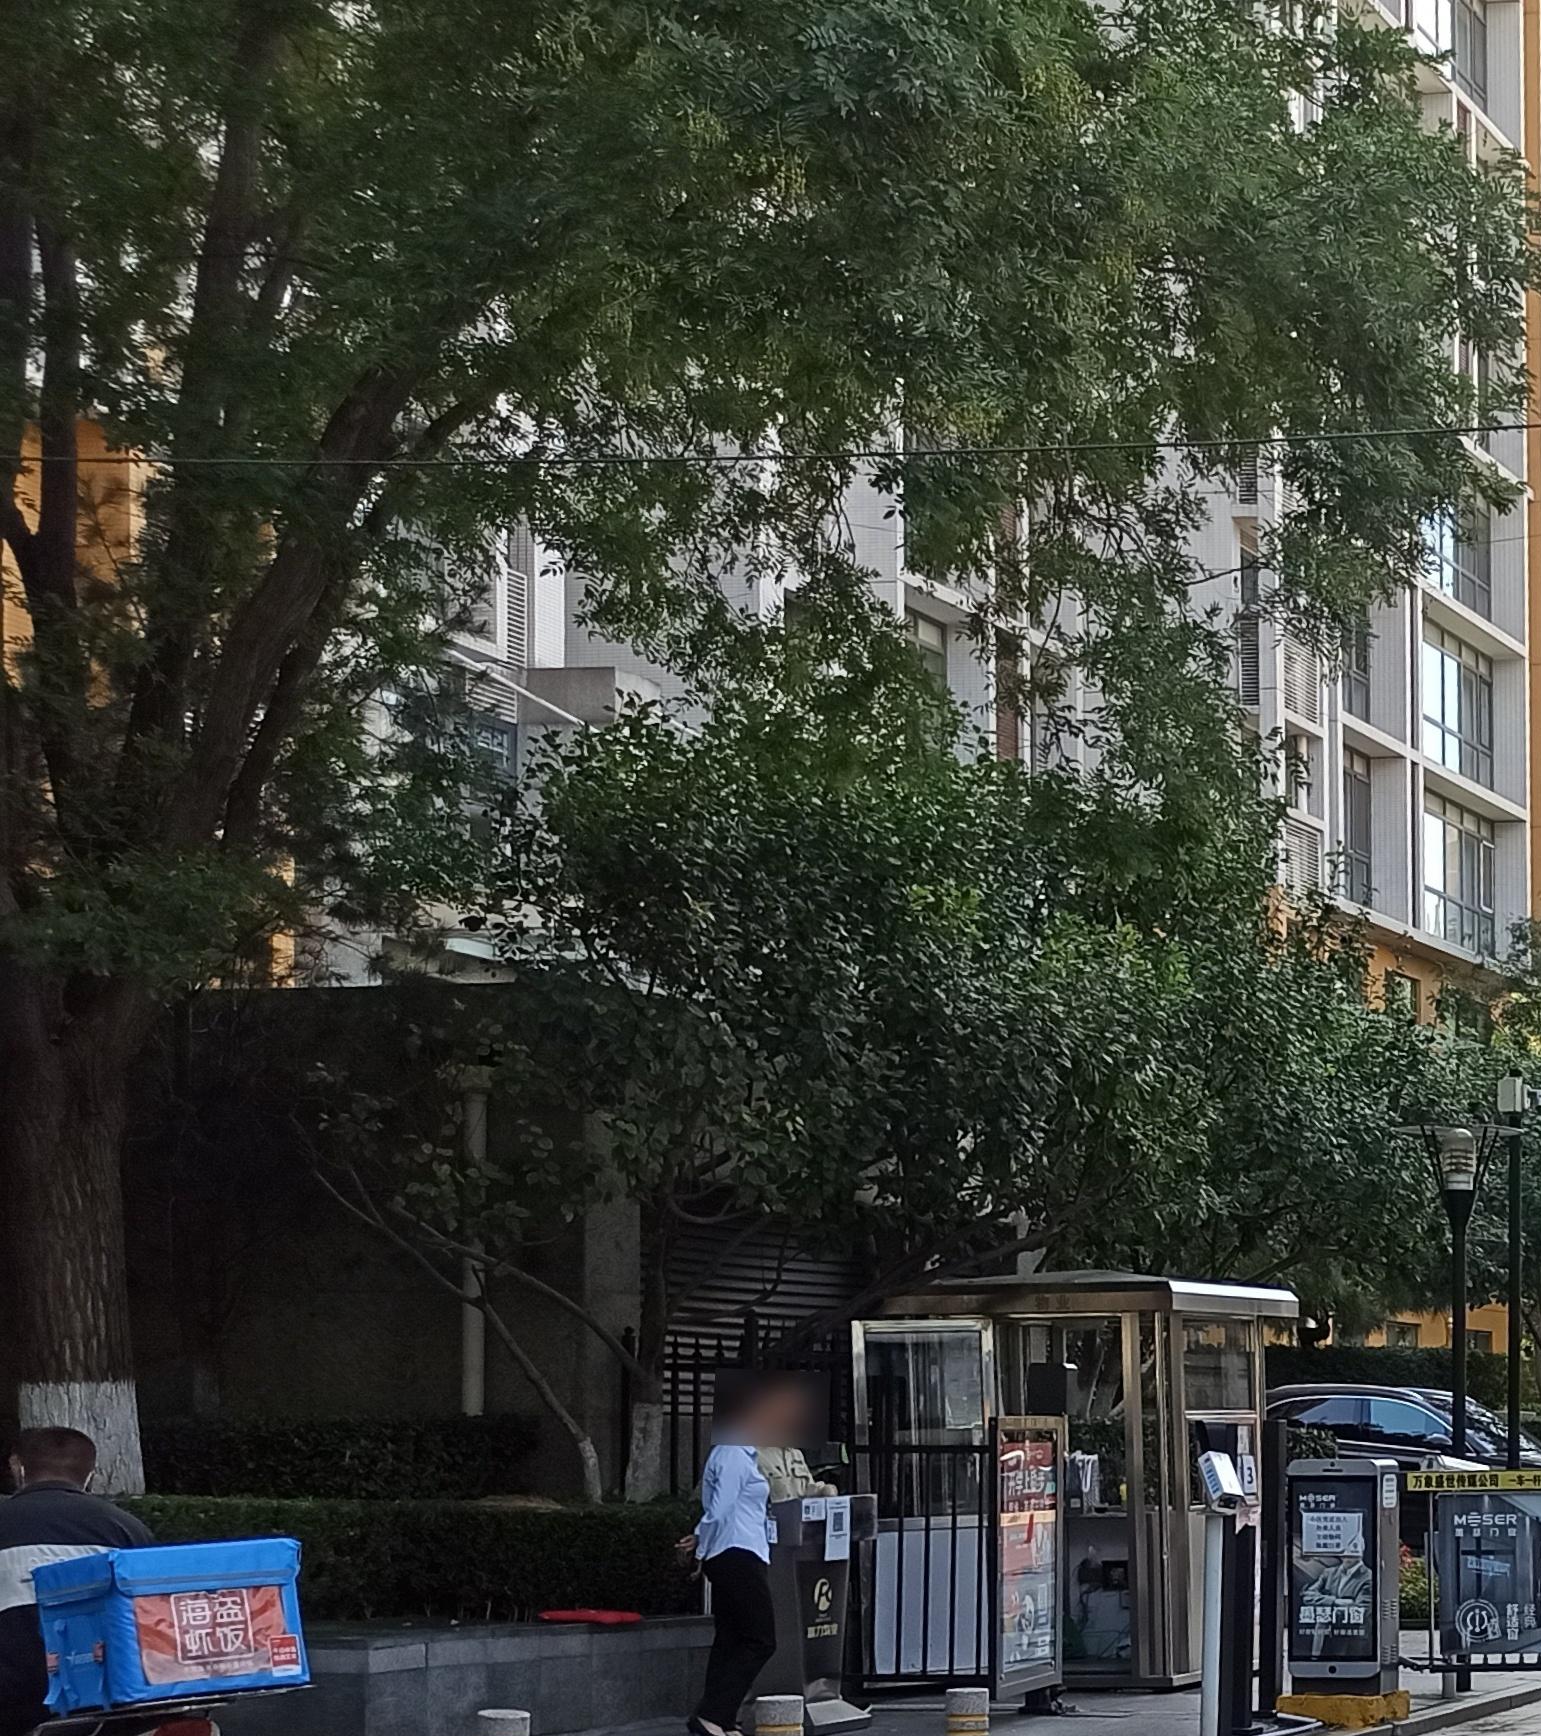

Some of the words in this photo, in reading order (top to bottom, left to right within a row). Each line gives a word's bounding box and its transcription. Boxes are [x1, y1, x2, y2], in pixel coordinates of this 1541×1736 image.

[1453, 1511, 1518, 1527] MOSER
[179, 1596, 245, 1625] 海盗
[184, 1625, 247, 1657] 虾饭
